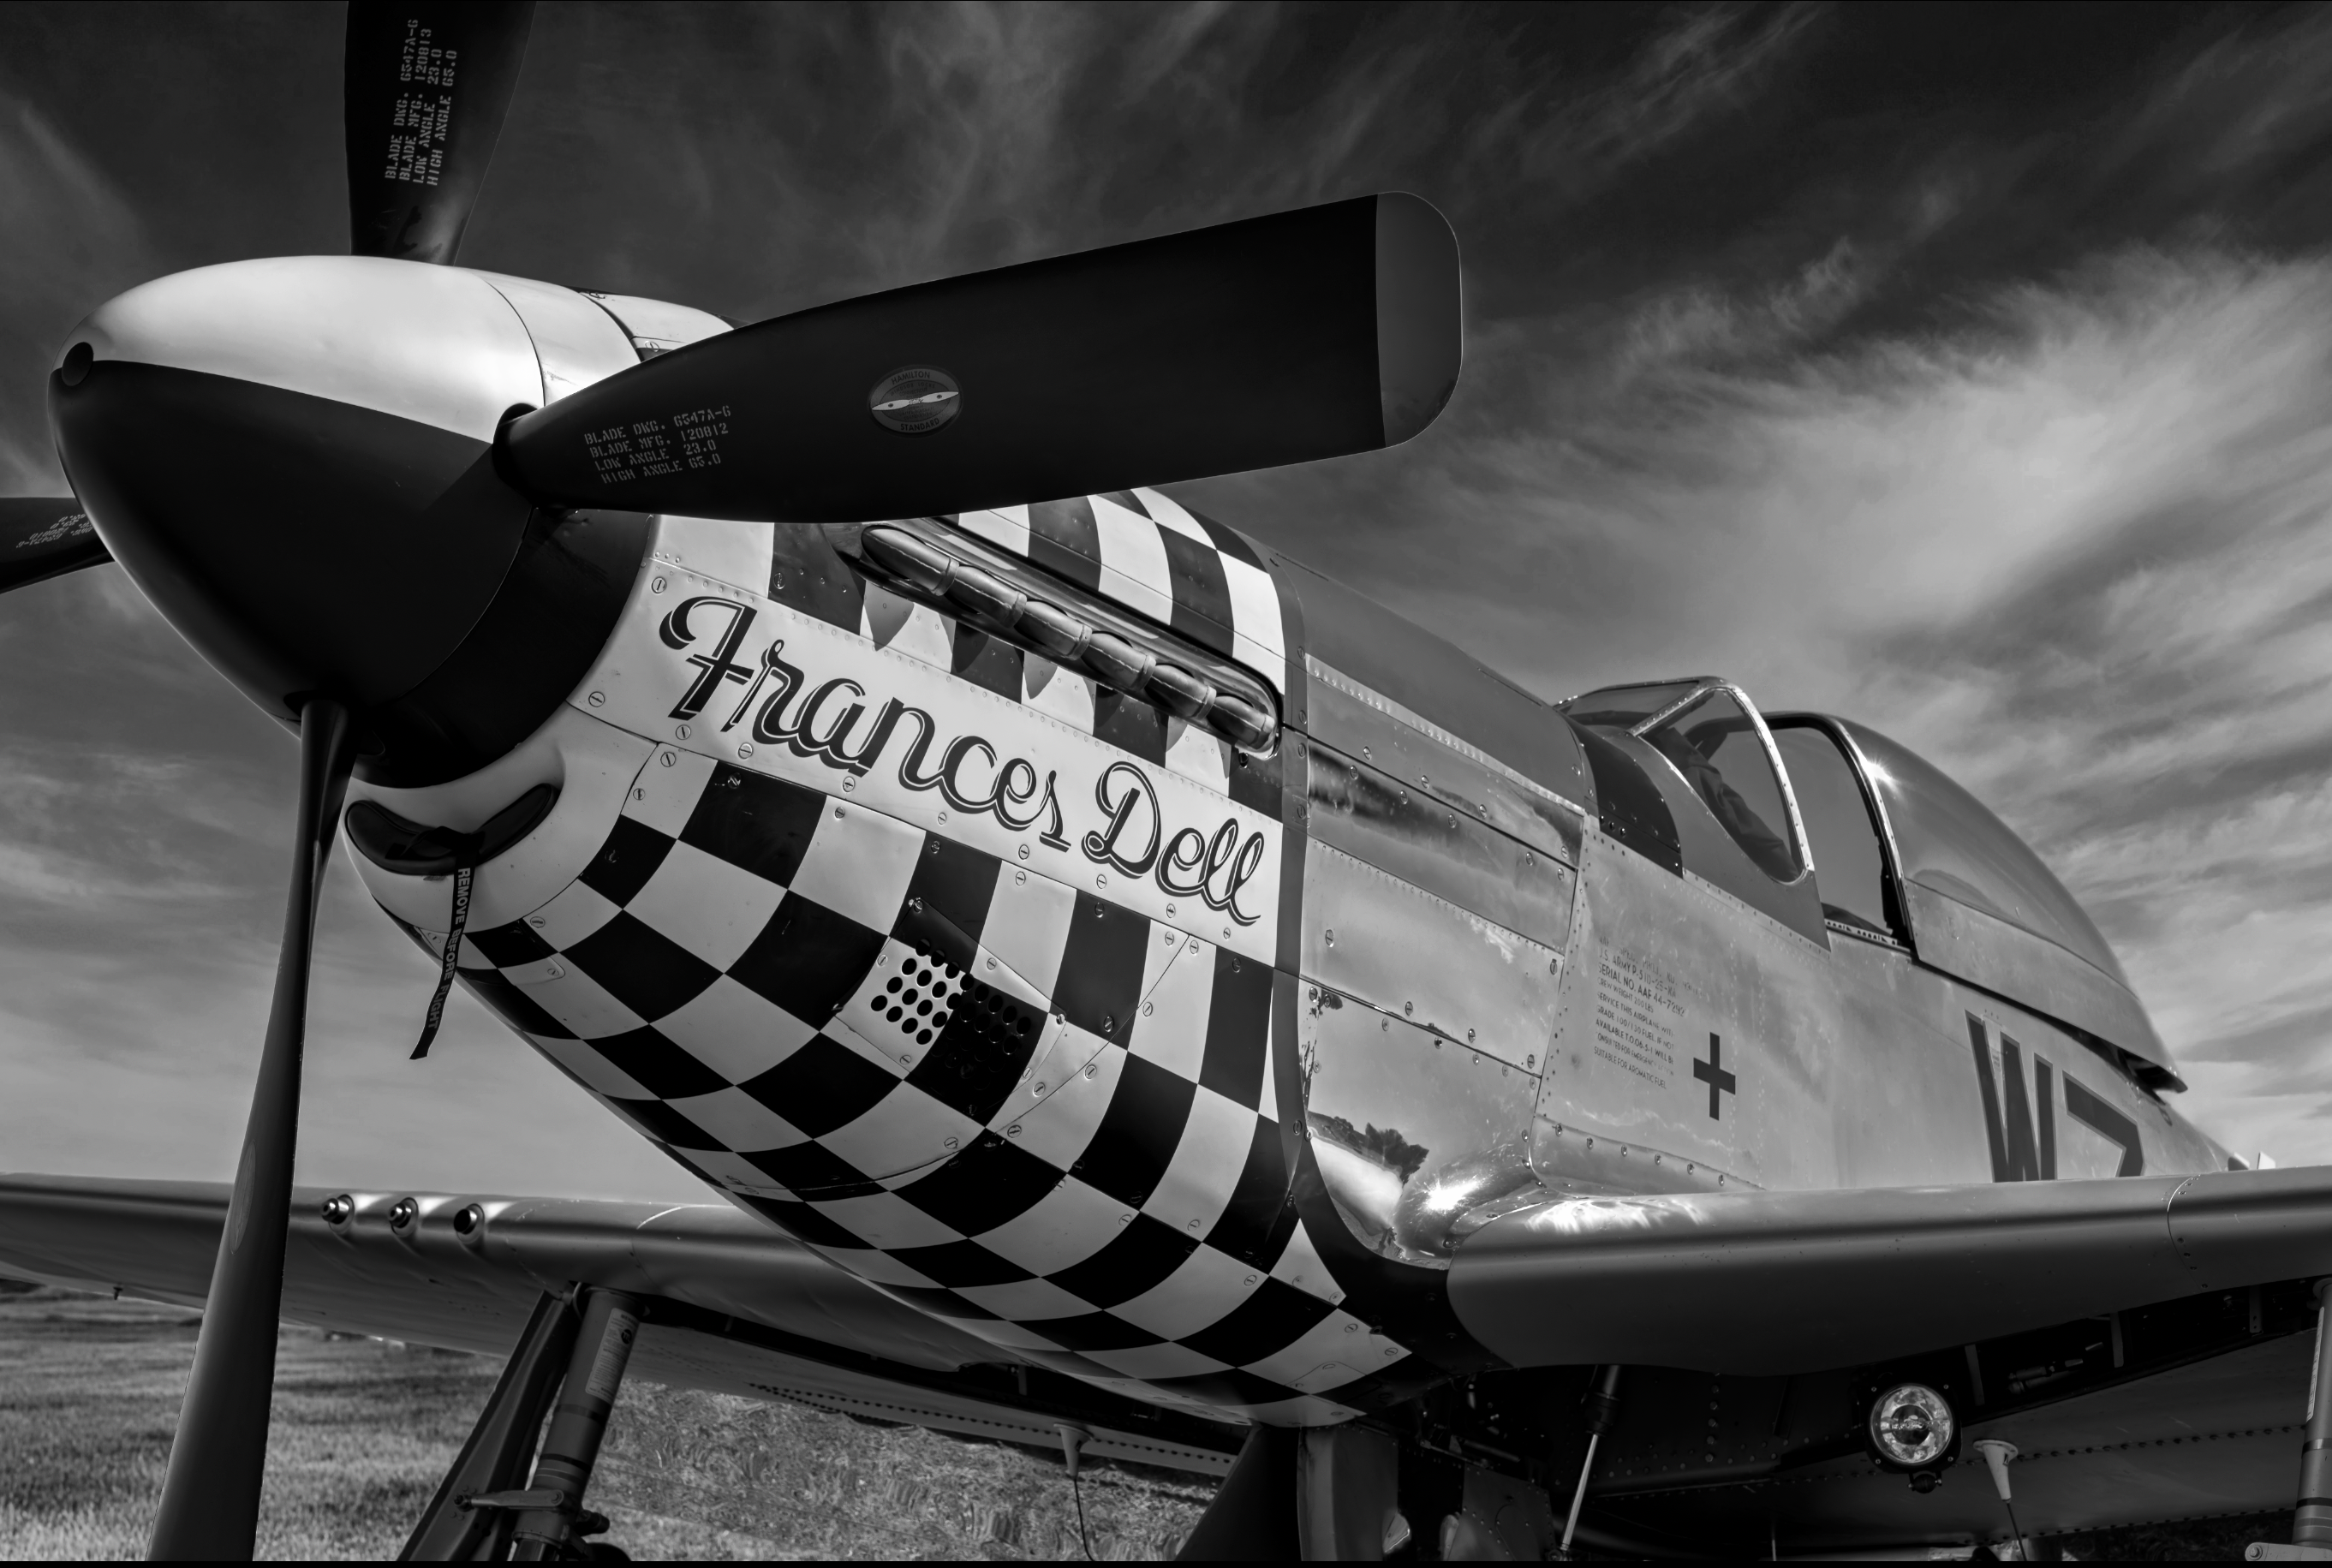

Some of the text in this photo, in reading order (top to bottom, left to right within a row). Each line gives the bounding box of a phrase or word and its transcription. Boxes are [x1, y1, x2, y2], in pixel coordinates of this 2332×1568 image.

[399, 28, 432, 180] BLADE MFG. 120813
[413, 49, 442, 183] LOW ANGLE 23.0
[434, 95, 451, 140] ANGLE
[385, 134, 403, 179] BLADE
[394, 93, 409, 126] DWG.
[426, 149, 443, 185] HIGH
[891, 384, 914, 396] WINDSOR
[892, 371, 930, 385] HAMILTON
[584, 426, 626, 444] BLADE
[633, 420, 665, 435] DWG.
[589, 422, 729, 458] BLADE MFG. 120812
[901, 418, 939, 431] STANDARD
[594, 439, 717, 471] LOW ANGLE 23.0
[601, 469, 635, 484] HIGH
[643, 461, 683, 477] ANGLE
[659, 594, 1265, 927] Frances Dell
[428, 867, 471, 1028] REMOVE BEFORE FLIGHT
[1612, 954, 1631, 973] ARMY
[1597, 976, 1654, 1013] CREW WEIGHT 200 LBS
[1598, 962, 1621, 984] SERIAL
[1623, 975, 1637, 992] NO.
[1637, 984, 1652, 1000] AAF
[1596, 1005, 1615, 1021] GRADE
[1616, 1016, 1642, 1034] 100/130
[1597, 991, 1619, 1010] SERVICE
[1620, 1003, 1632, 1017] THIS
[1633, 1011, 1660, 1031] AIRPLANE
[1595, 1017, 1625, 1039] AVAILABLE
[1655, 1048, 1667, 1062] WILL
[1667, 1055, 1674, 1064] BE
[1595, 1031, 1621, 1051] ONSULTED
[1621, 1044, 1631, 1056] FOR
[1594, 1046, 1667, 1089] SUITABLE FOR AROMATIC FUEL
